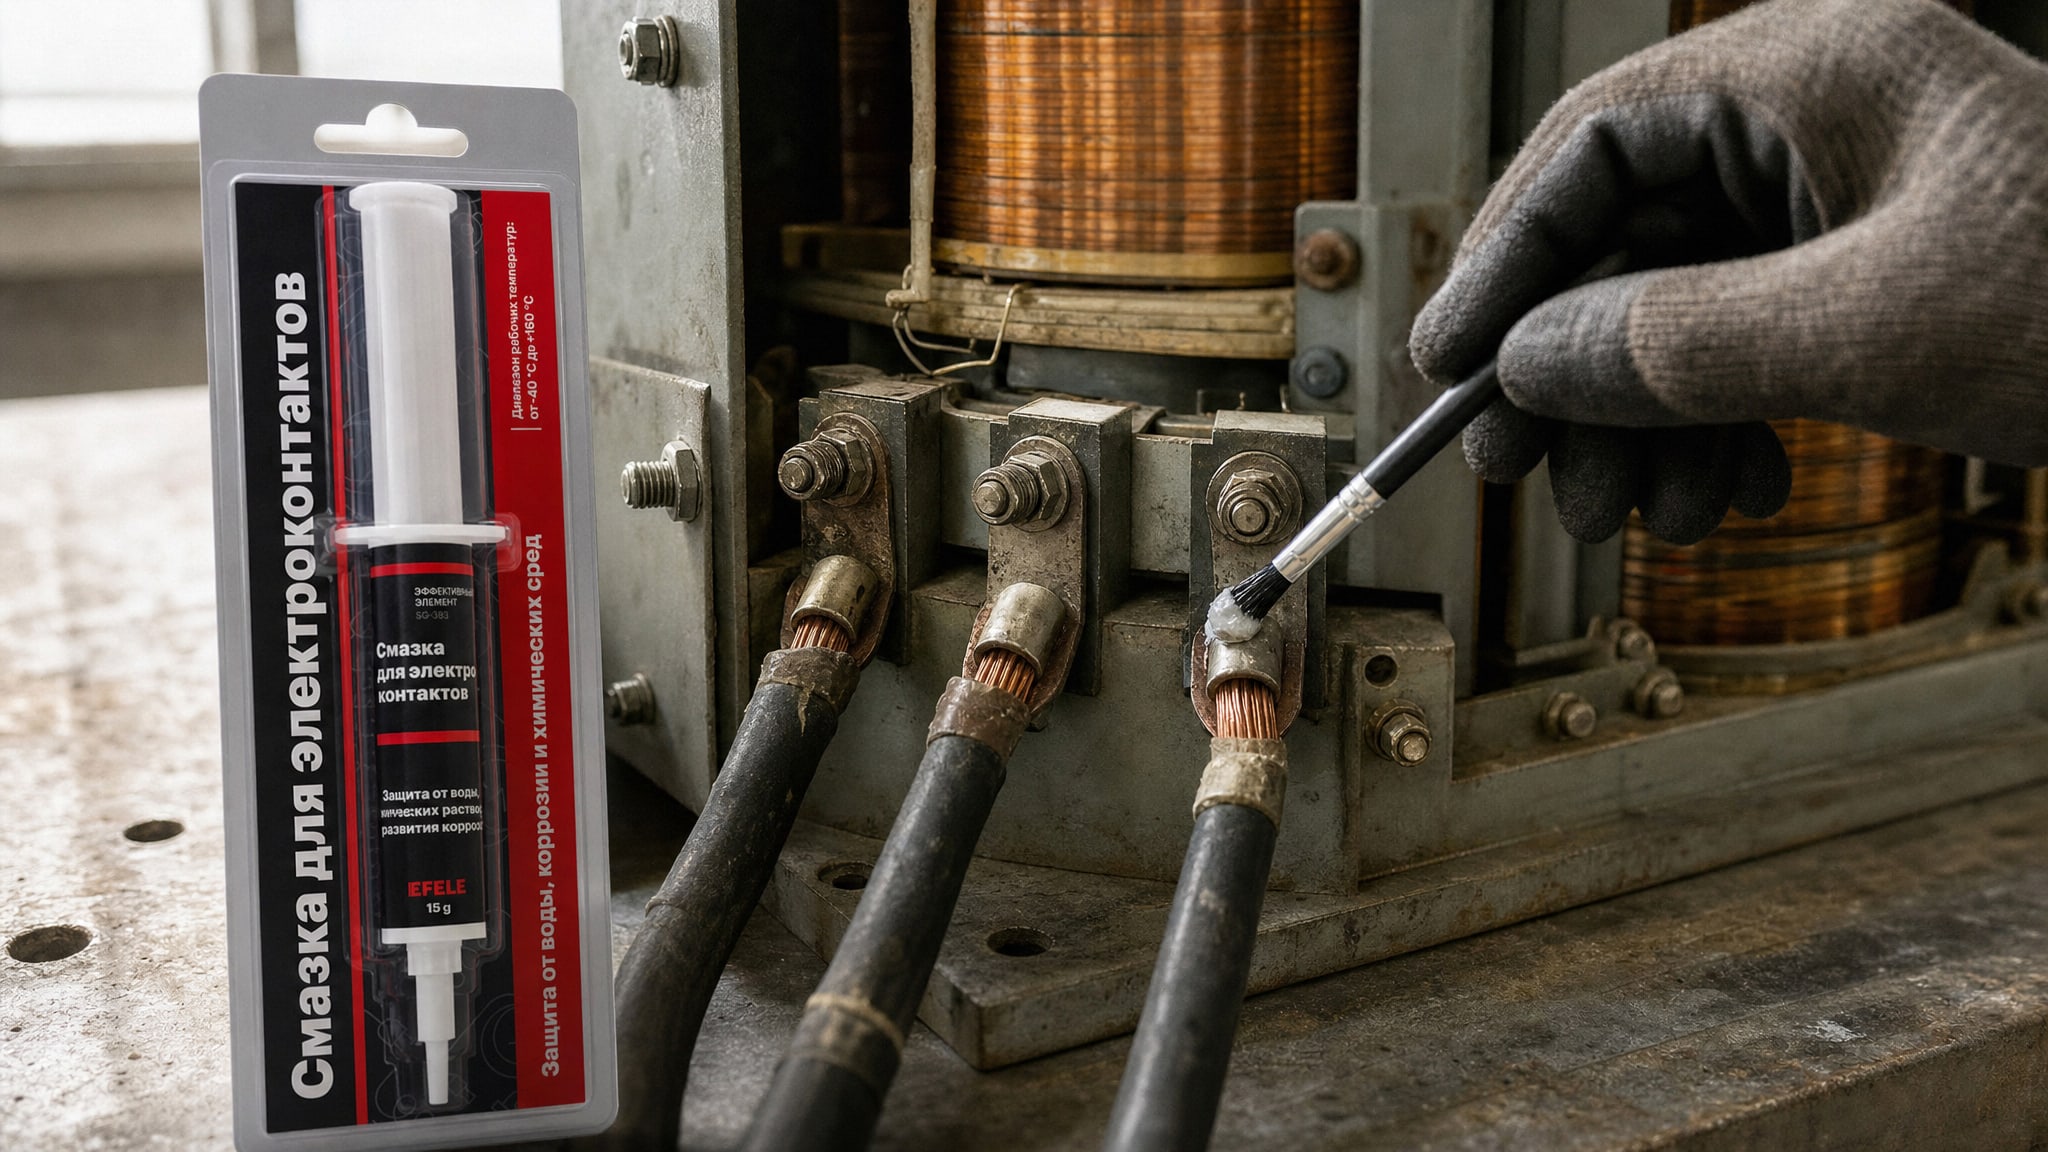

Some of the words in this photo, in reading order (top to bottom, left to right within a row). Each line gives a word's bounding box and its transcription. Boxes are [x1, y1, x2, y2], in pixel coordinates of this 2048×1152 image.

[527, 344, 539, 362] до
[275, 271, 327, 773] электроконтактов
[525, 534, 545, 592] сред
[414, 597, 458, 607] ЭЛЕМЕНТ
[376, 642, 445, 659] Смазка
[376, 666, 406, 684] для
[408, 665, 477, 682] электро
[527, 595, 547, 740] химических
[378, 687, 469, 704] контактов
[534, 744, 548, 758] и
[382, 789, 430, 803] Защита
[432, 789, 449, 799] от
[534, 763, 556, 877] коррозии
[292, 784, 334, 881] для
[381, 823, 440, 838] развития
[407, 879, 467, 897] EFELE
[426, 902, 441, 914] 15
[442, 903, 451, 915] g
[539, 881, 558, 951] воды,
[541, 954, 557, 982] от
[291, 893, 334, 1099] Смазка
[541, 986, 561, 1077] Защита
